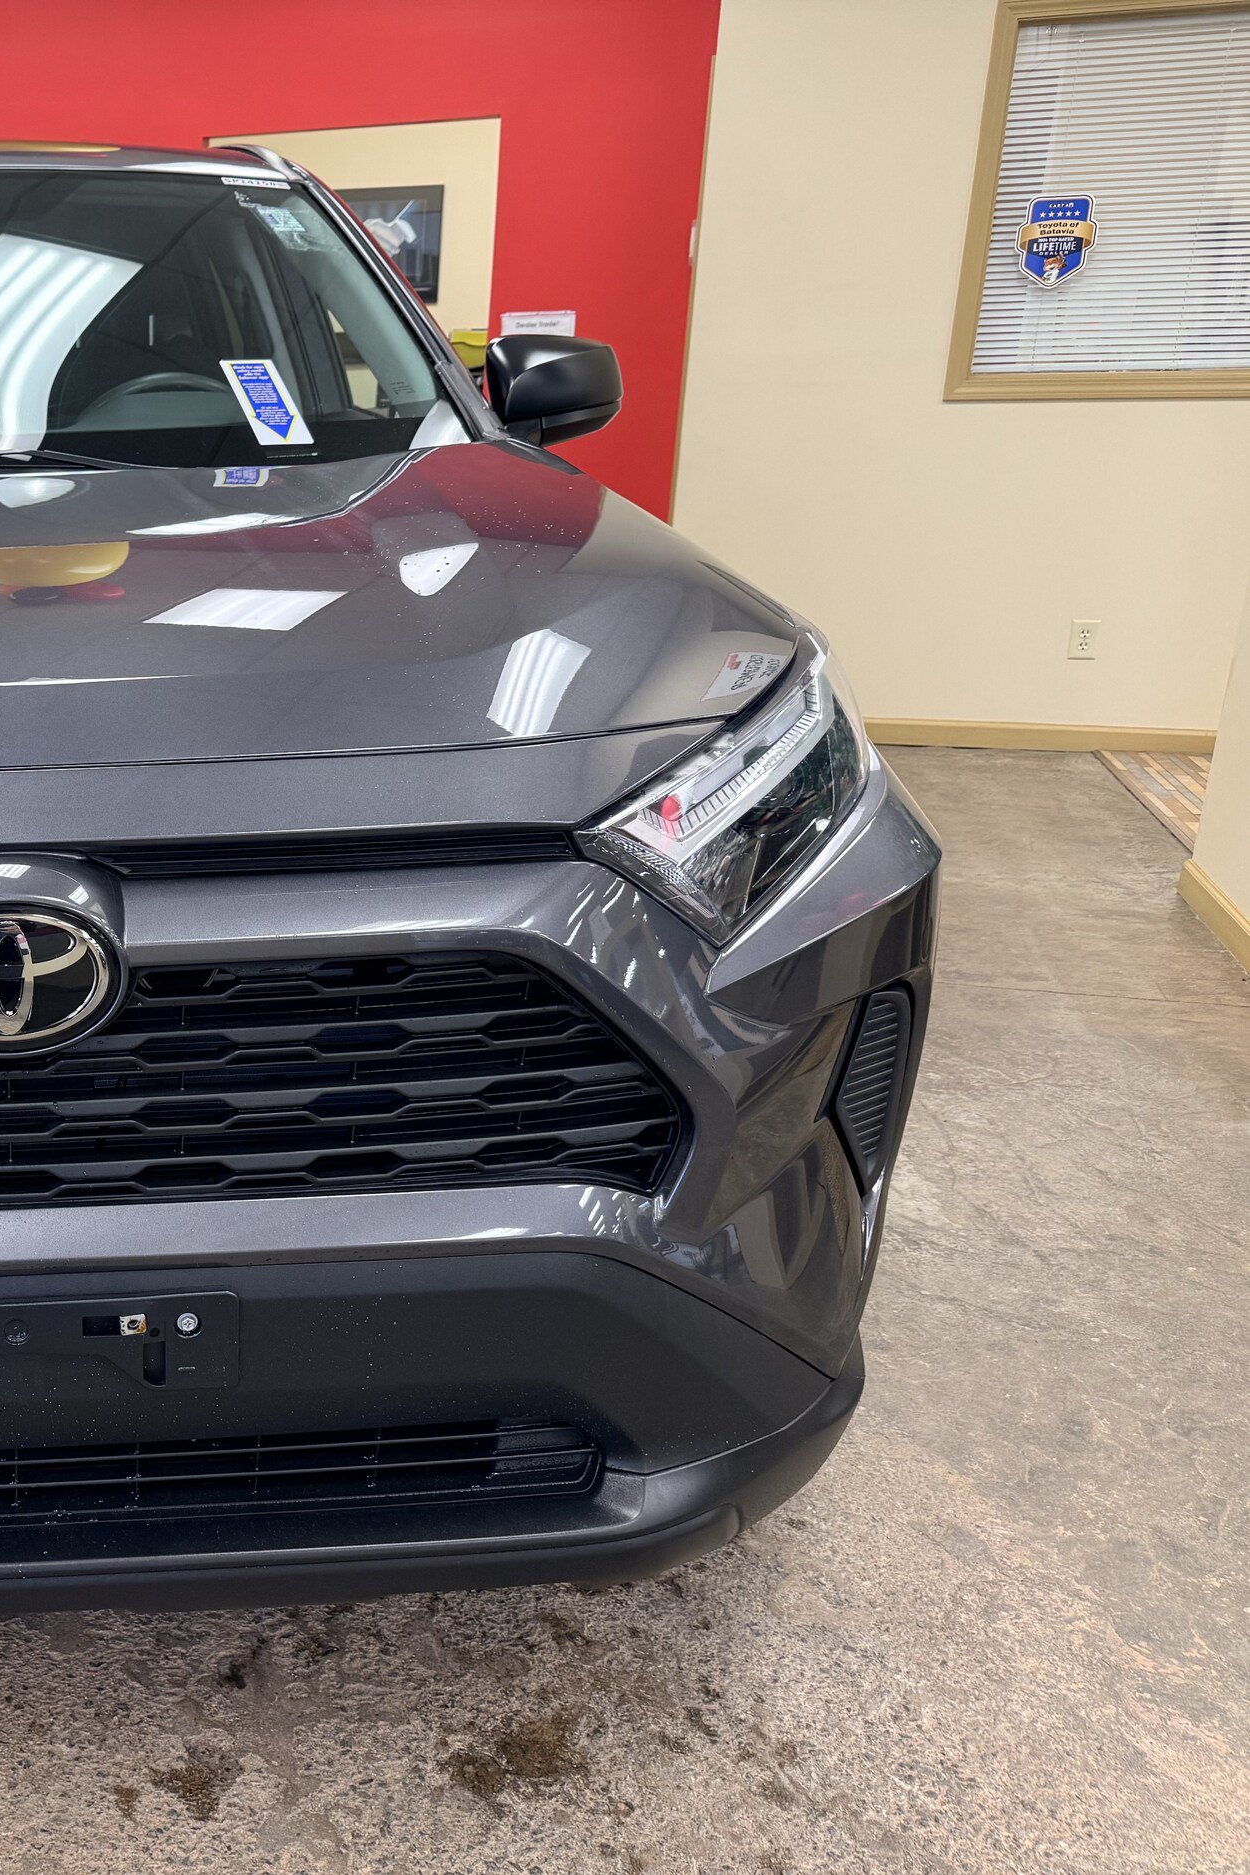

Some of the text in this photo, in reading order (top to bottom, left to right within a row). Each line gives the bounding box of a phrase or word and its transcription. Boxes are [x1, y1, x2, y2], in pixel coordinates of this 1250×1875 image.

[1038, 222, 1068, 230] Toyota
[1040, 228, 1075, 236] Batavia
[1033, 241, 1077, 252] LIFETIME
